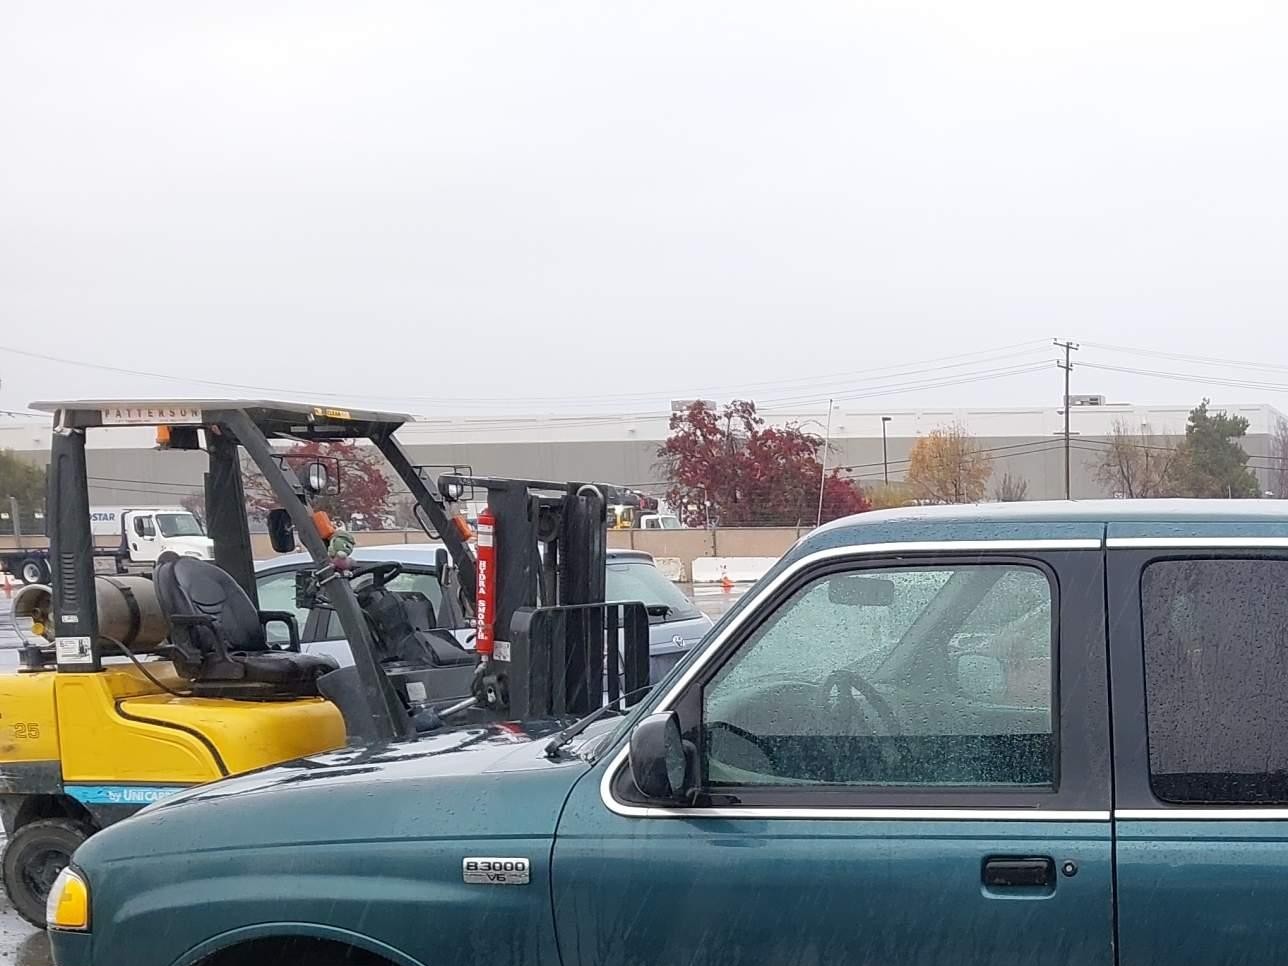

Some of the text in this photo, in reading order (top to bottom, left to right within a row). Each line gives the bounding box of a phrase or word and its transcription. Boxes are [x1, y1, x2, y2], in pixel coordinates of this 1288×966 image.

[103, 407, 198, 418] PATTERSON
[88, 512, 115, 522] STAR
[477, 559, 487, 640] HYDRA SMOOTH
[15, 722, 40, 739] 25
[123, 788, 174, 801] UNICAR
[466, 861, 526, 872] B3000
[486, 873, 507, 882] V6
